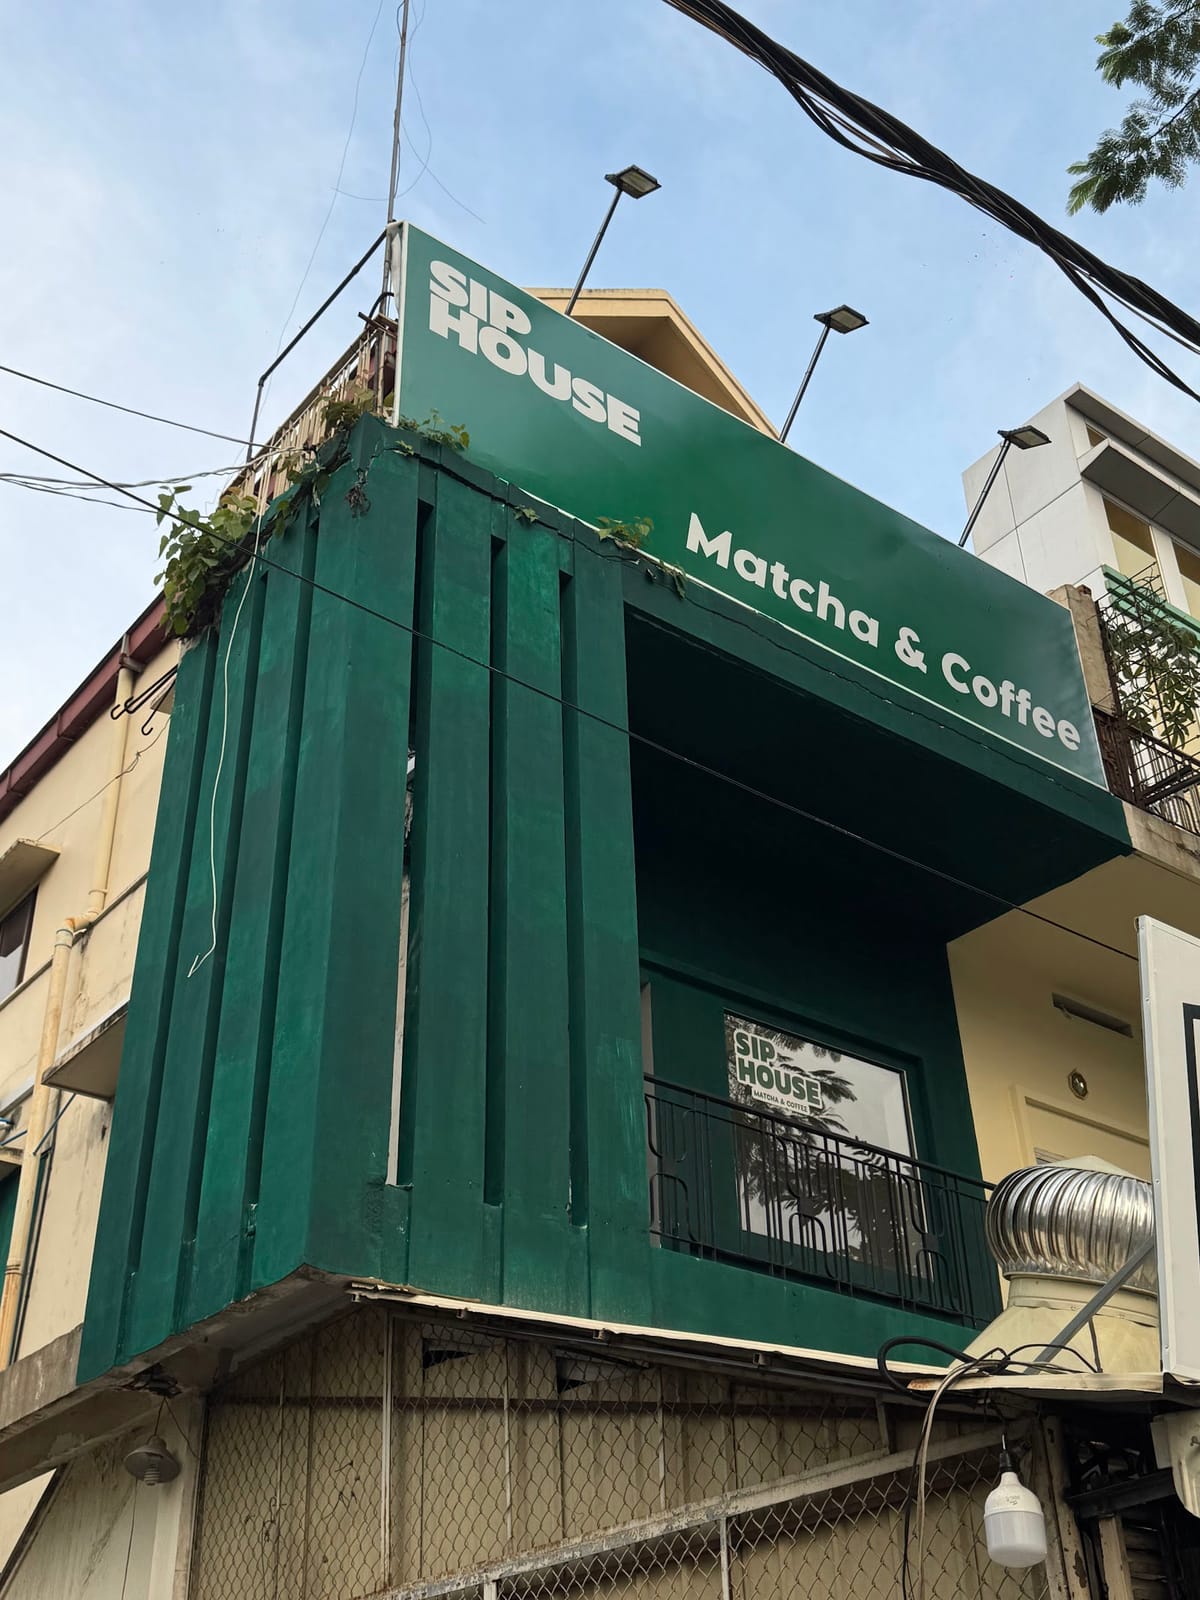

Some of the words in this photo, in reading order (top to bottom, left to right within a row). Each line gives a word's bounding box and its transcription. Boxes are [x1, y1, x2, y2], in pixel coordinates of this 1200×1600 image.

[429, 260, 532, 335] SIP
[429, 293, 642, 447] HOUSE
[686, 512, 879, 648] Matcha
[894, 627, 927, 673] &
[941, 652, 1081, 751] Coffee
[735, 1031, 776, 1062] SIP
[738, 1057, 821, 1106] HOUSE
[753, 1090, 779, 1104] MATCHA
[786, 1100, 809, 1113] COFFEE
